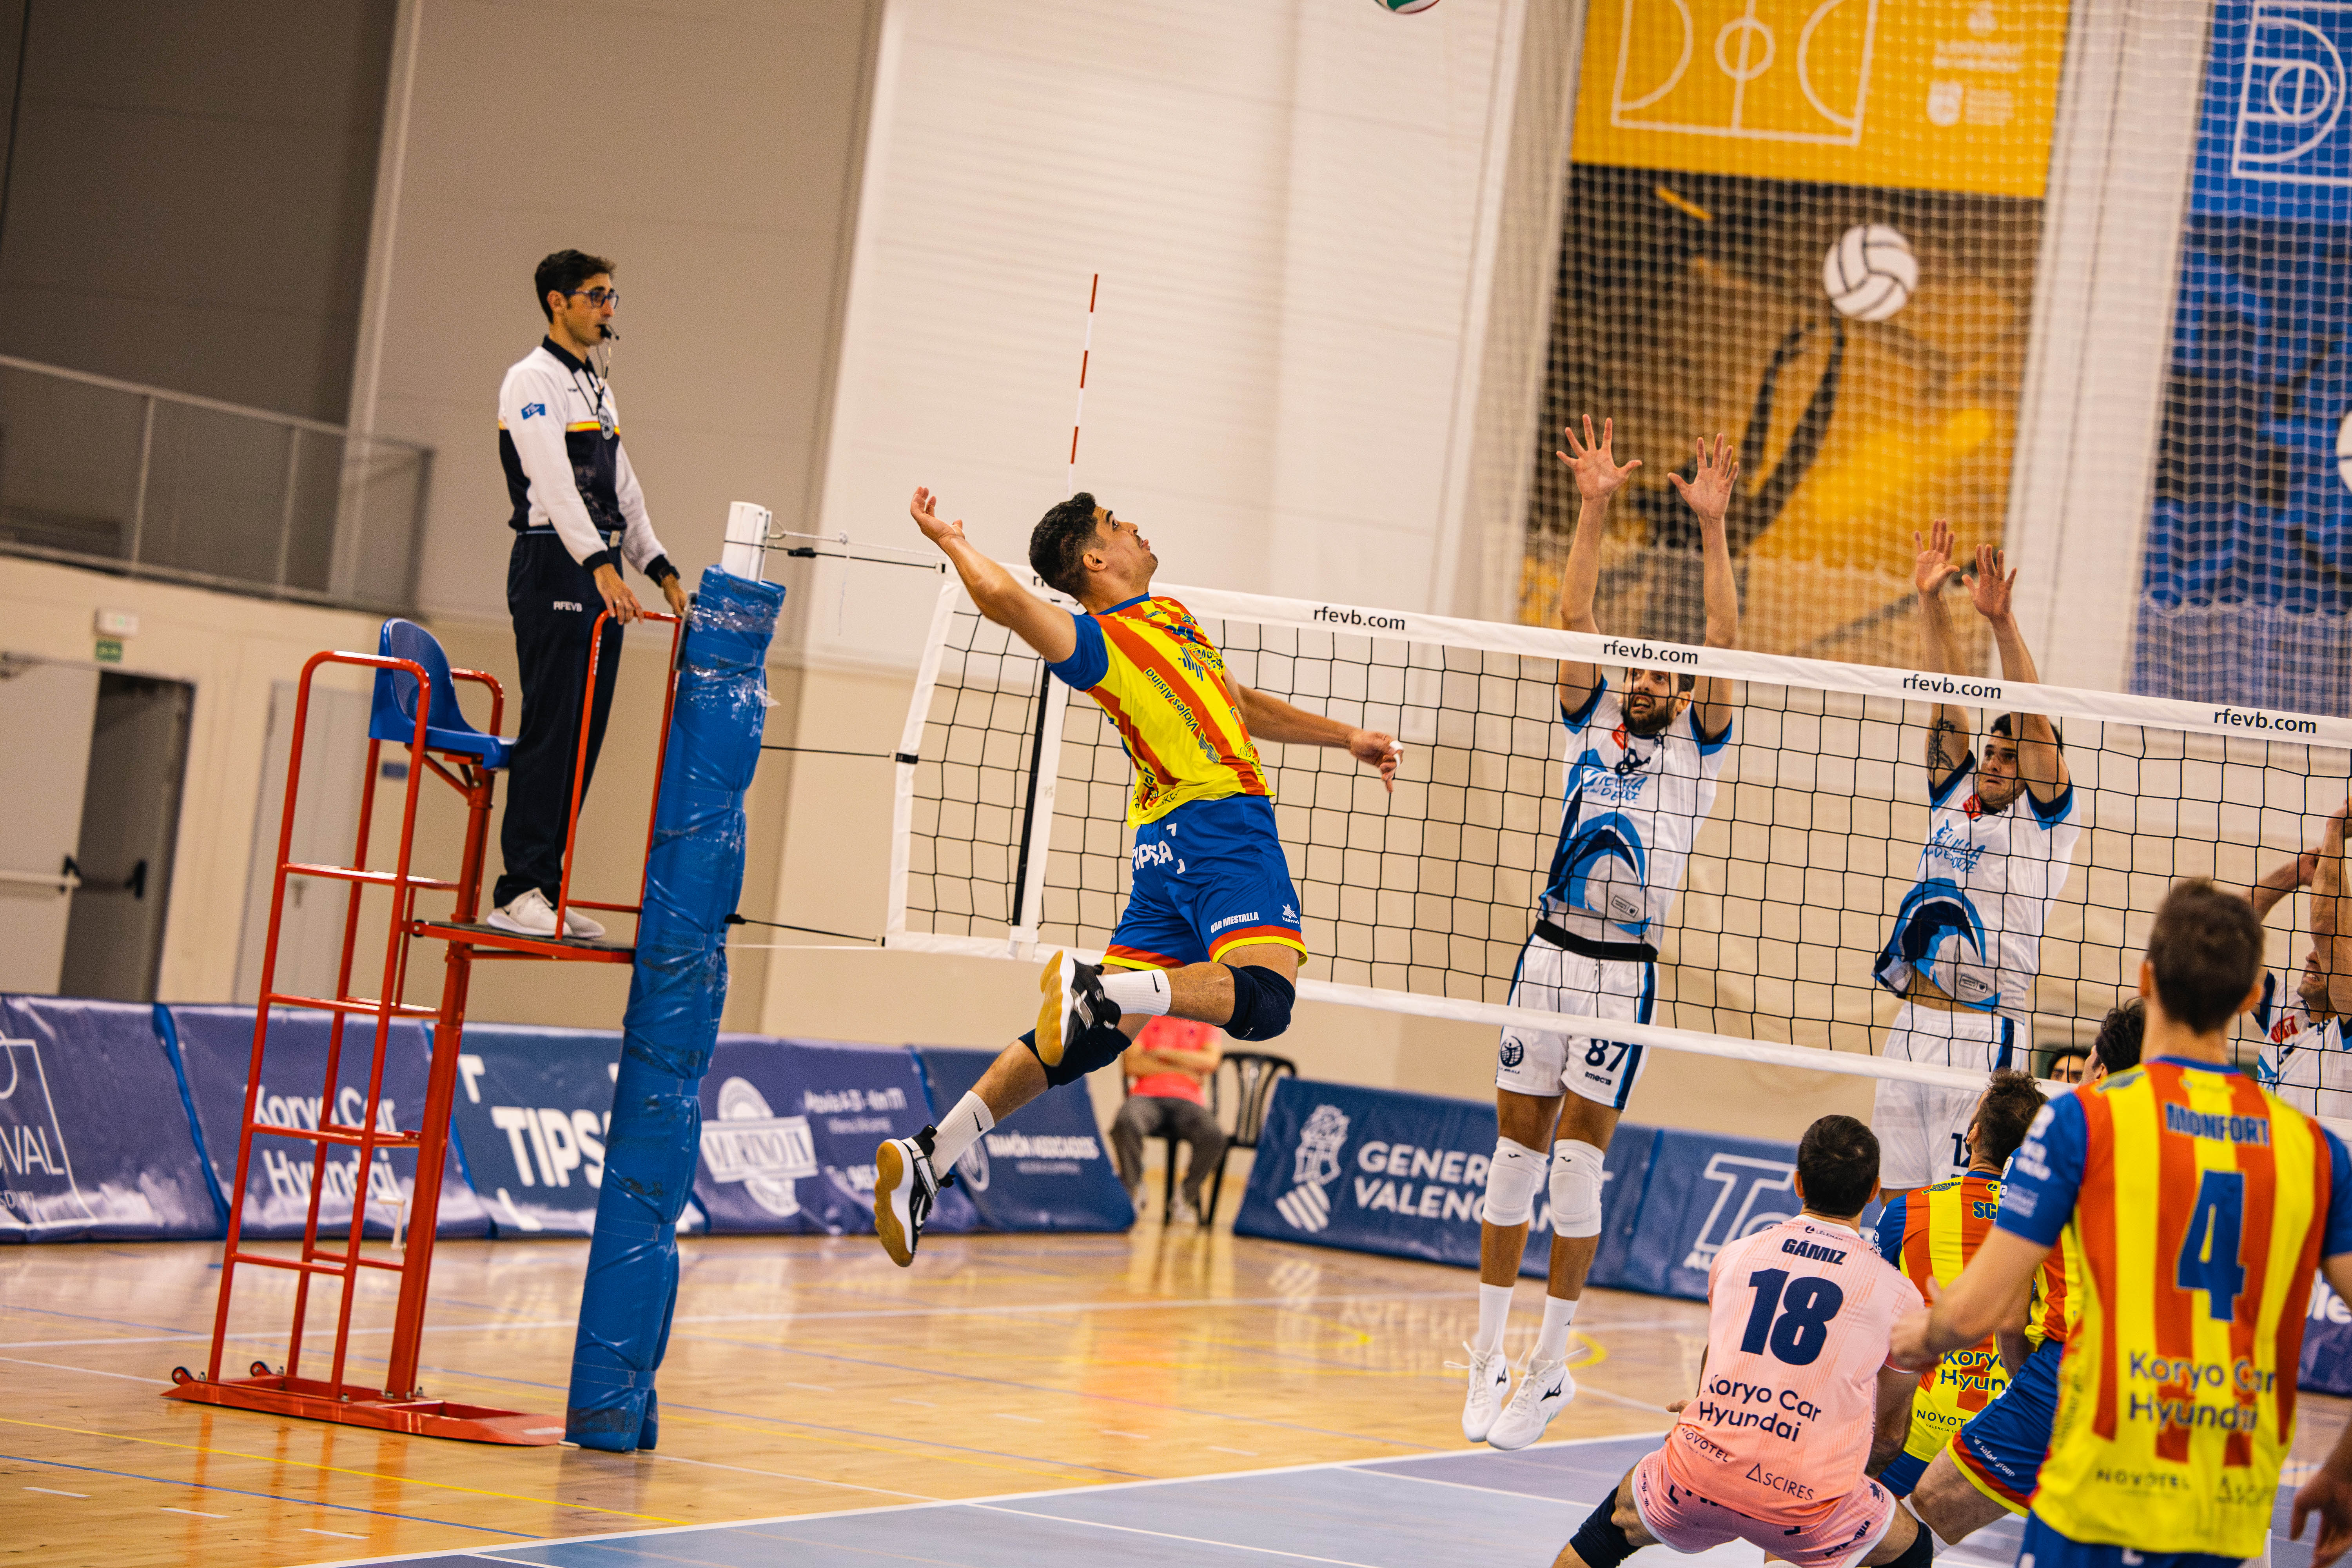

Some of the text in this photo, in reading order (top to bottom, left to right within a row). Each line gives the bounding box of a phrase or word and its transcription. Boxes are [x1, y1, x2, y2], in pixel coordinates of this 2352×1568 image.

[1314, 606, 1405, 630] rfevb.com
[1603, 640, 1698, 664] rfevb.com
[1903, 674, 2001, 699] rfevb.com
[2214, 708, 2317, 733] rfevb.com
[1210, 912, 1259, 934] BAR MESTALLA
[1585, 1038, 1630, 1073] 87
[2165, 1102, 2270, 1148] MONFORT
[1782, 1238, 1847, 1265] GÁMIZ
[2177, 1170, 2247, 1321] 4
[1740, 1268, 1844, 1366] 18
[2129, 1351, 2225, 1392] Koryo
[1699, 1401, 1802, 1442] Hyundai
[1779, 1390, 1822, 1422] Car
